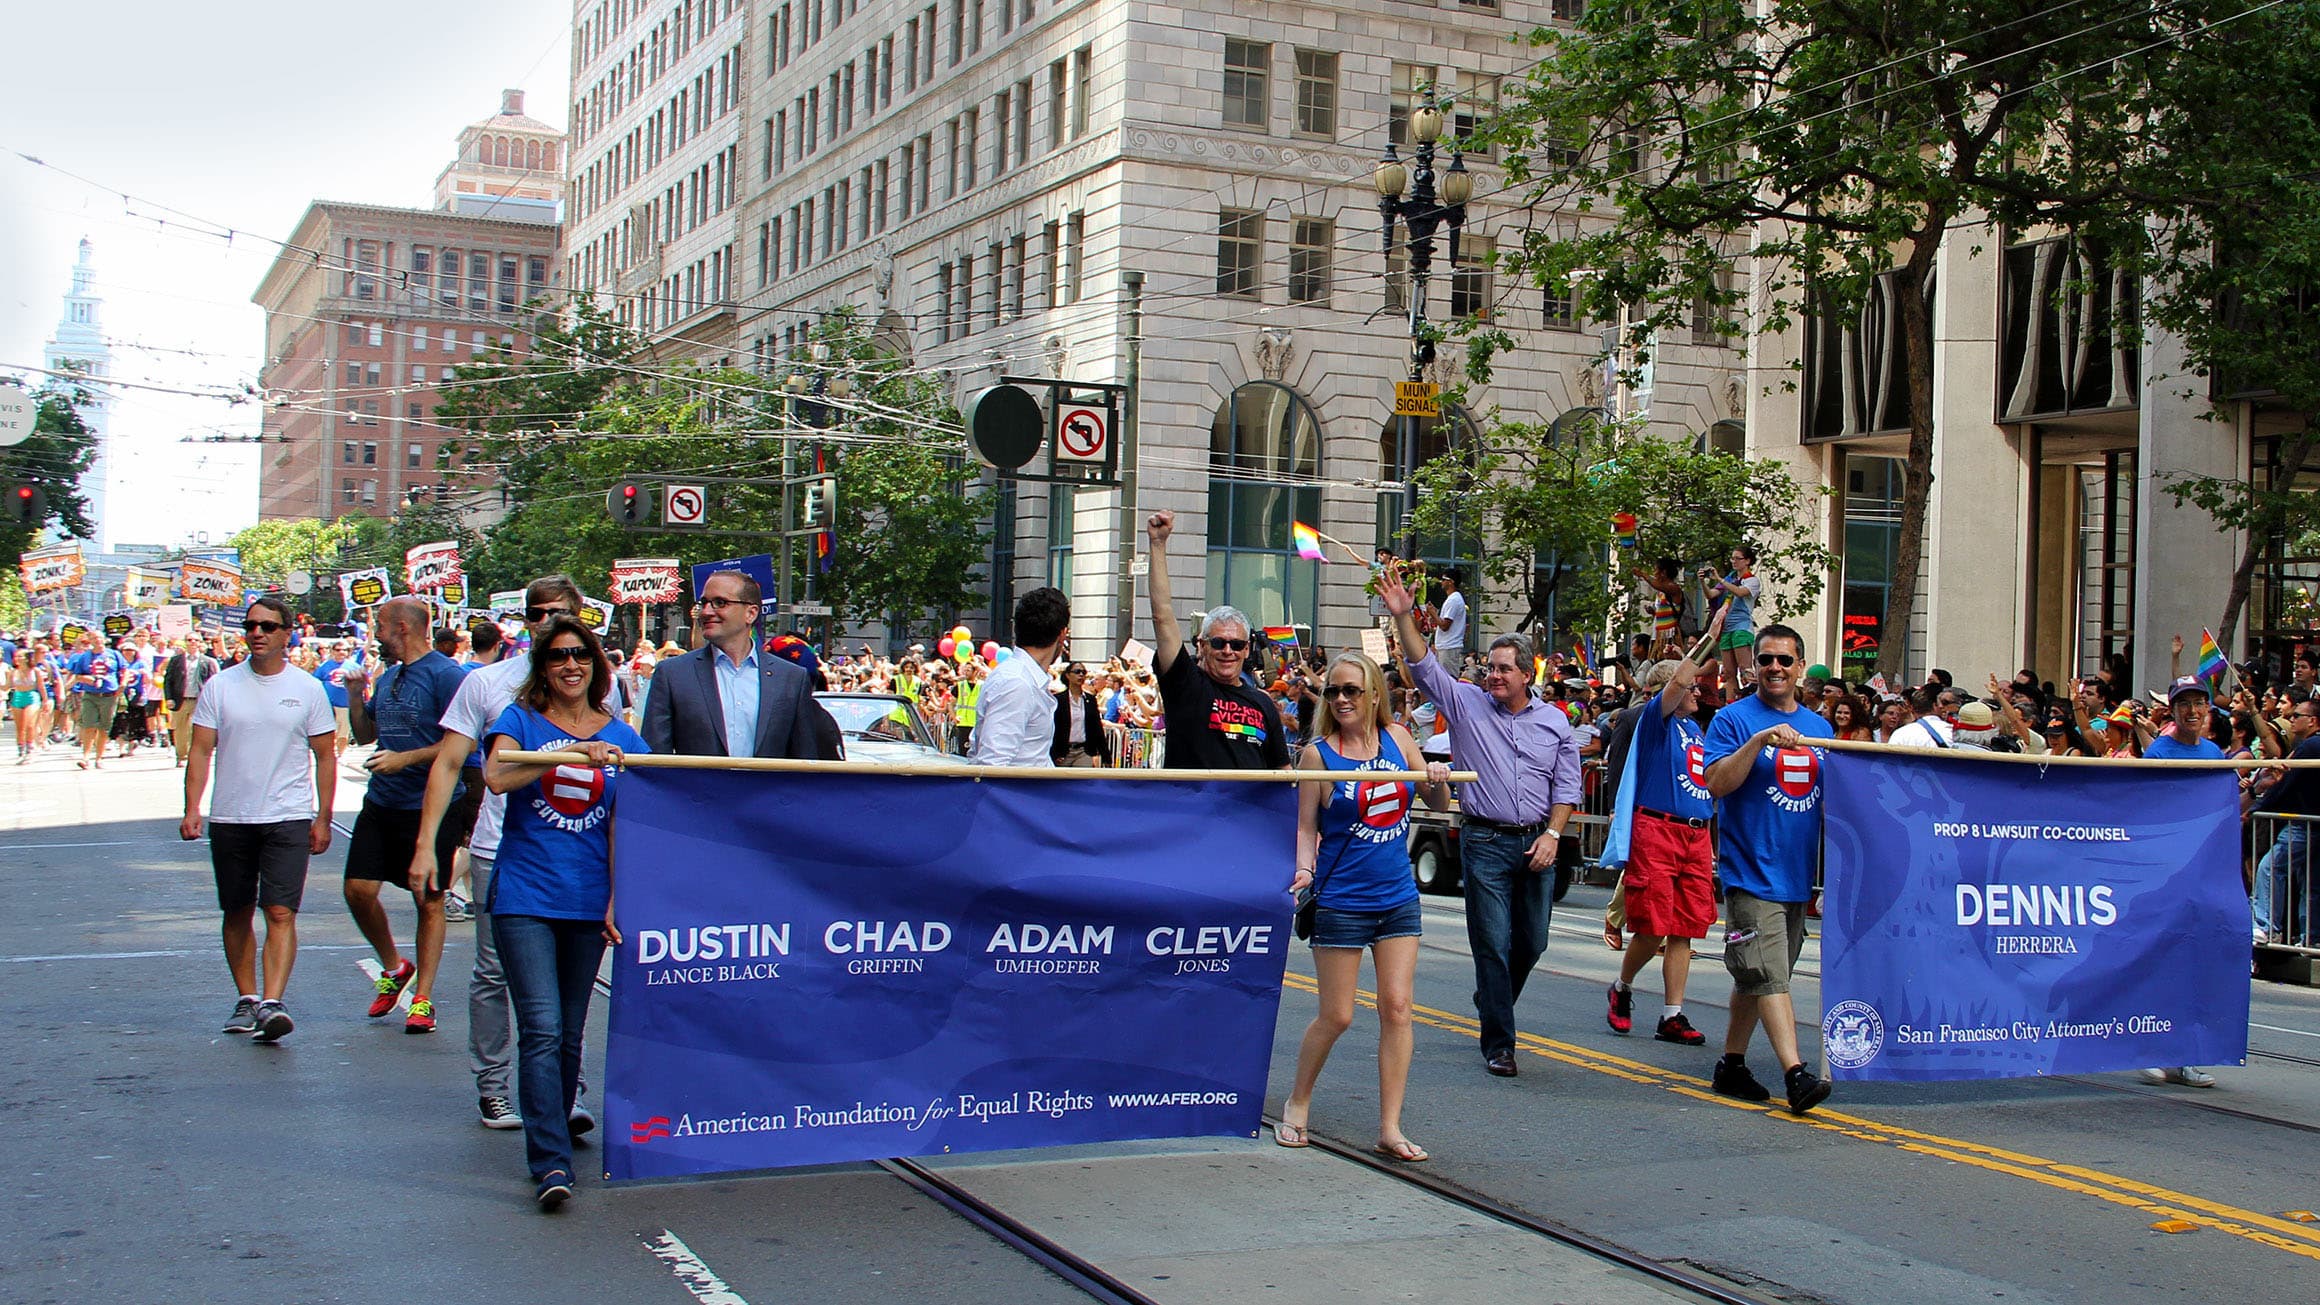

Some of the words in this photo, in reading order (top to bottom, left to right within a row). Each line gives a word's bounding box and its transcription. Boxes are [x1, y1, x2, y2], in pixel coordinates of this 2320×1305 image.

[1403, 383, 1431, 397] MUNI
[1396, 398, 1436, 412] SIGNAL
[35, 565, 66, 580] ZONK!
[193, 577, 229, 593] ZONK!
[622, 577, 667, 592] KAPOW!
[1871, 677, 1886, 689] NO
[1765, 785, 1821, 813] SUPERHERO
[531, 798, 606, 833] SUPERHERO
[1933, 822, 1968, 837] PROP
[1971, 824, 1981, 837] 8
[1982, 824, 2040, 839] LAWSUIT
[2042, 826, 2131, 841] CO-COUNSEL
[1956, 884, 2118, 926] DENNIS
[638, 922, 790, 964] DUSTIN
[824, 920, 951, 954] CHAD
[985, 922, 1114, 955] ADAM
[1145, 924, 1272, 956] CLEVE
[1995, 935, 2079, 955] HERRERA
[647, 968, 714, 986] LANCE
[718, 963, 780, 983] BLACK
[847, 957, 924, 975] GRIFFIN
[995, 958, 1101, 975] UMHOEFER
[1174, 957, 1231, 976] JONES
[1896, 1023, 1934, 1044] San
[1938, 1020, 2008, 1043] Francisco
[2011, 1020, 2041, 1042] City
[2043, 1015, 2124, 1040] Attorney's
[2128, 1013, 2173, 1034] Office
[673, 1111, 786, 1138] American
[794, 1100, 916, 1130] Foundation
[916, 1096, 956, 1130] for
[957, 1092, 1019, 1122] Equal
[1027, 1089, 1093, 1120] Rights
[1108, 1091, 1239, 1109] WWW.AFER.ORG
